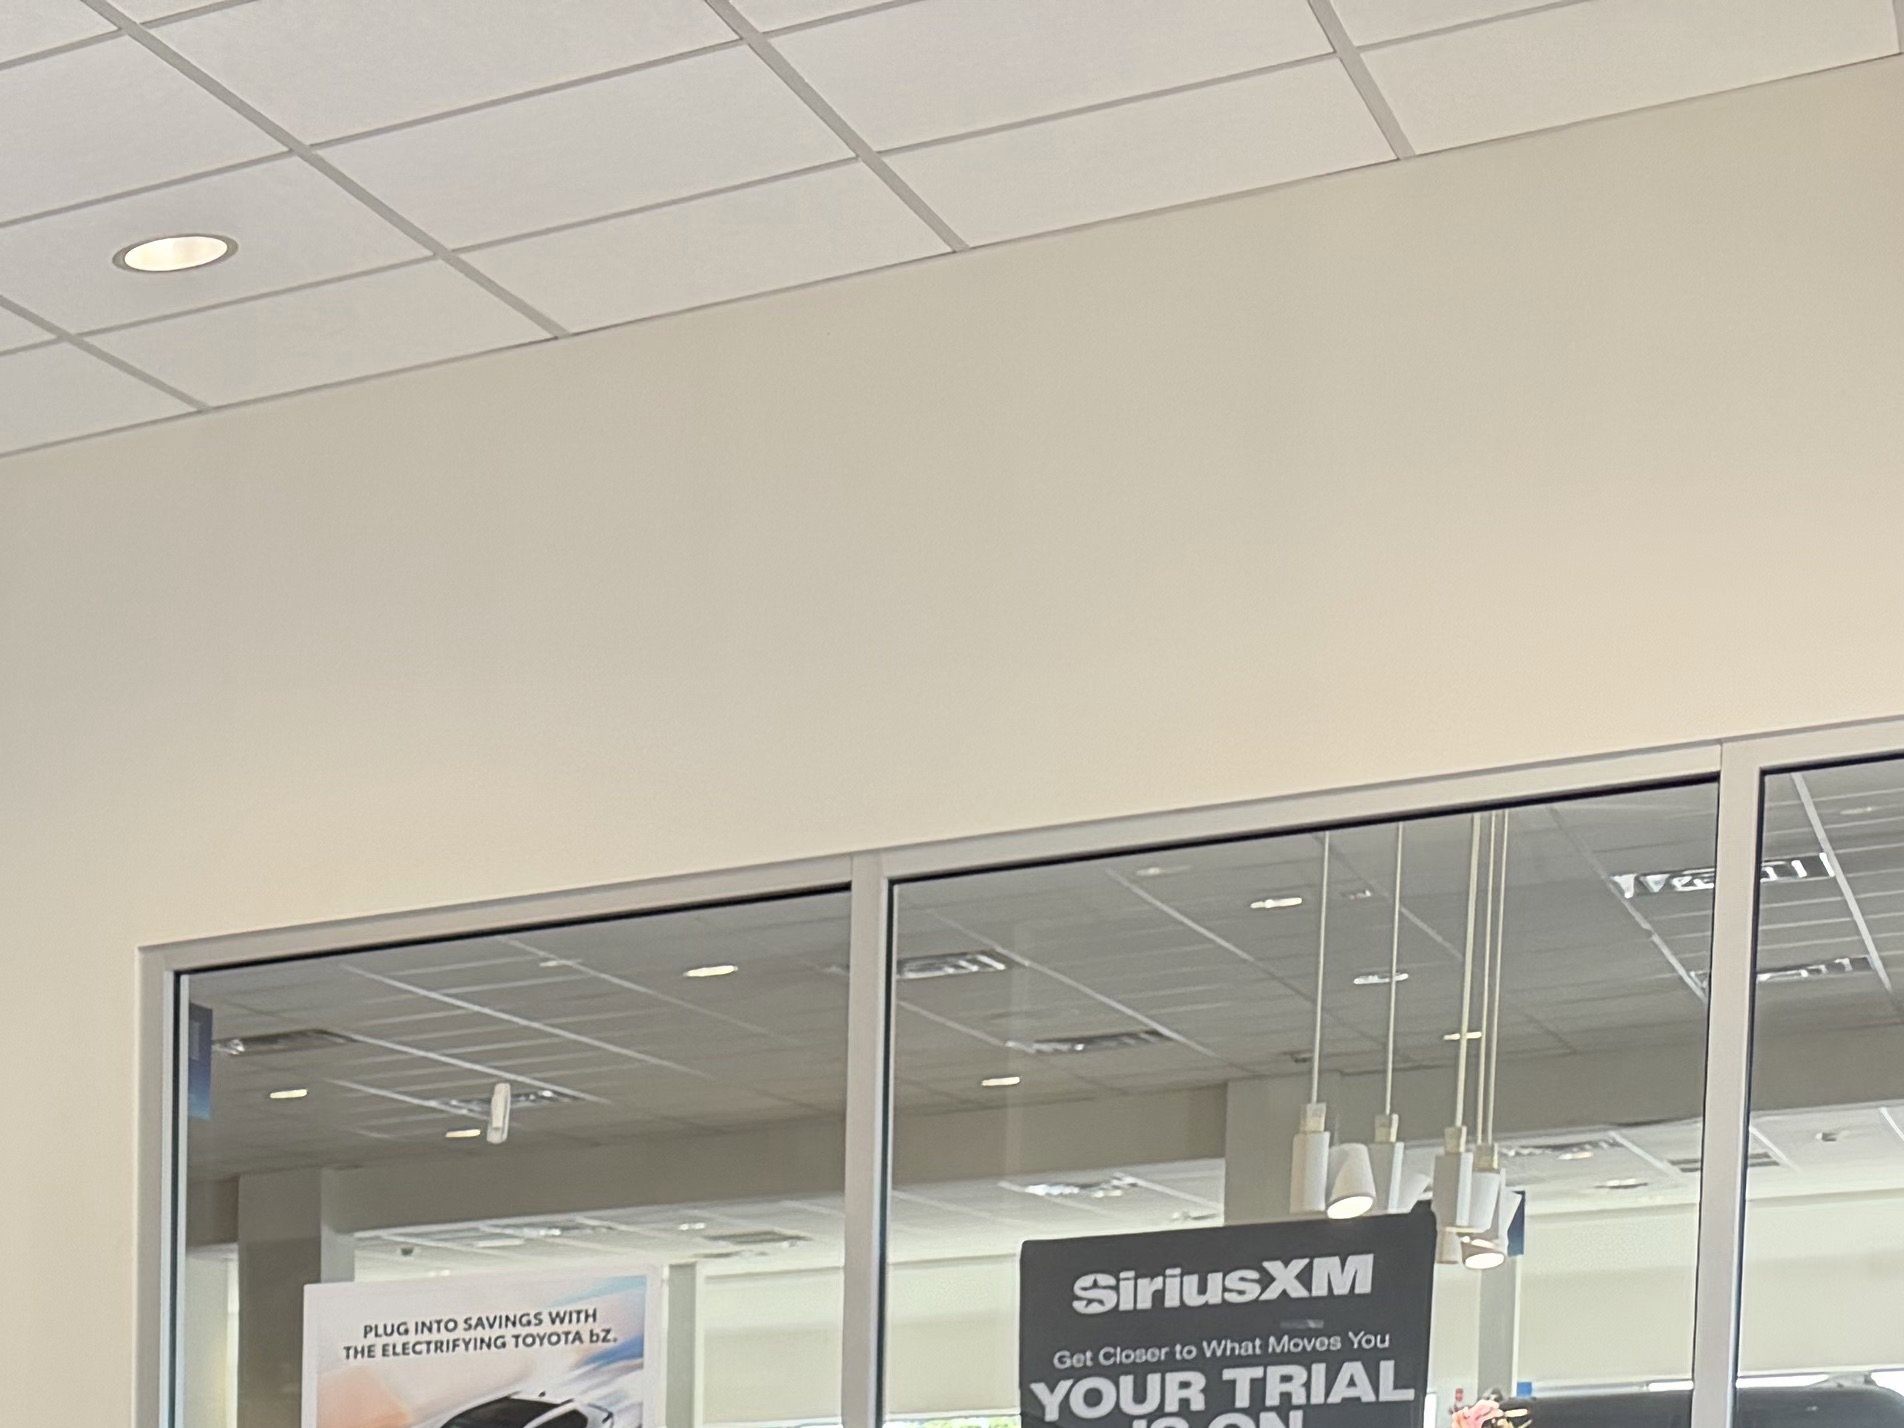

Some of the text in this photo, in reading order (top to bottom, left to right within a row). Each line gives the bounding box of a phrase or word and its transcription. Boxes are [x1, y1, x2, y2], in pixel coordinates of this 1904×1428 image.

[1071, 1253, 1375, 1314] SiriusXM
[363, 1308, 597, 1339] PLUG INTO SAVINGS WITH
[343, 1343, 377, 1360] THE
[381, 1335, 507, 1358] ELECTRIFYING
[512, 1331, 584, 1348] TOYOTA
[1052, 1330, 1390, 1370] Get Closer to What Moves You
[1029, 1359, 1416, 1423] YOUR TRIAL
